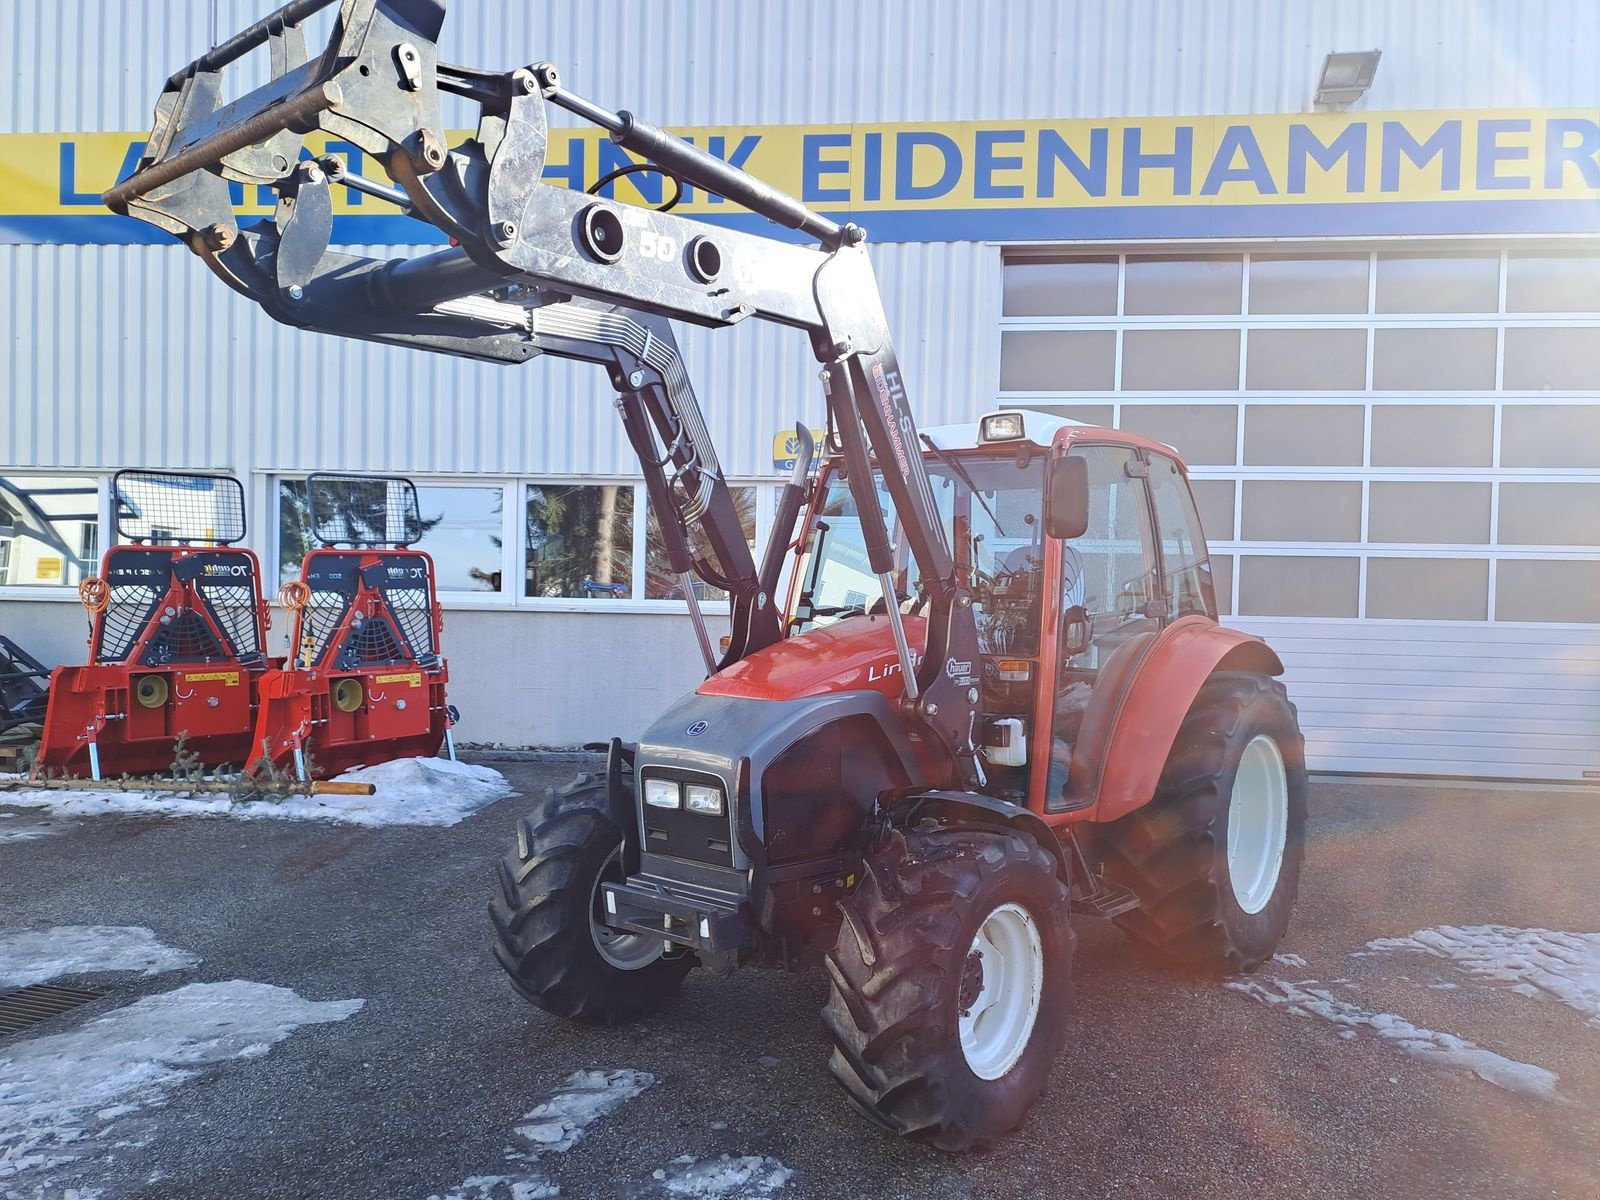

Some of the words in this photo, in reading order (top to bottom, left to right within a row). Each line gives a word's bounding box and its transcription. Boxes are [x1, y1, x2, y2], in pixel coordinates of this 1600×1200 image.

[802, 118, 1600, 202] EIDENHAMMER
[640, 230, 676, 263] 50
[886, 371, 912, 434] HL-S
